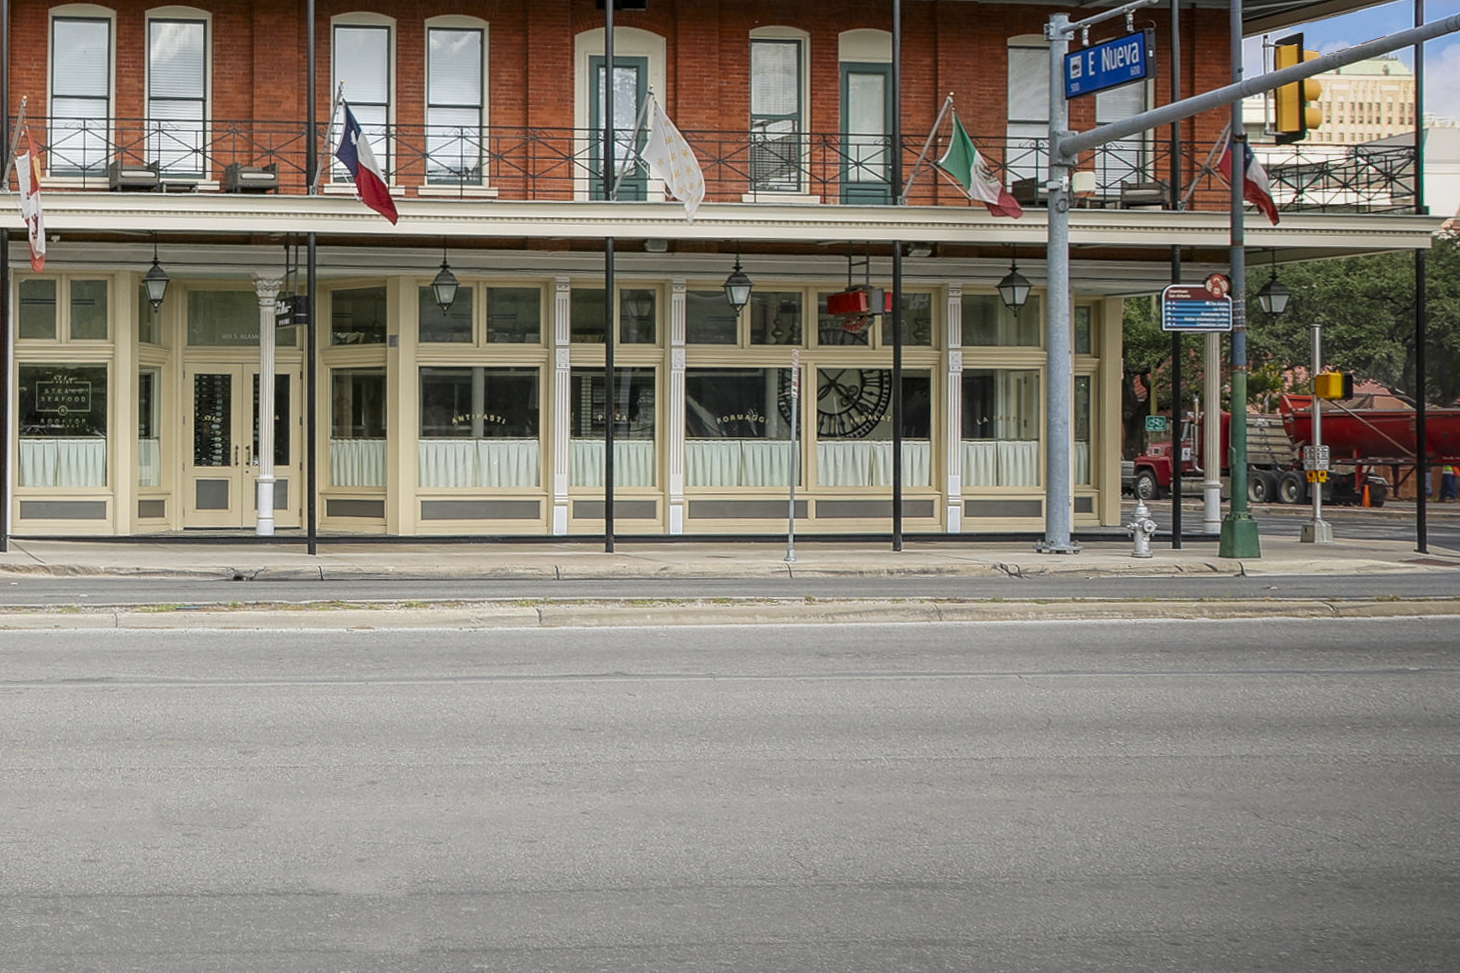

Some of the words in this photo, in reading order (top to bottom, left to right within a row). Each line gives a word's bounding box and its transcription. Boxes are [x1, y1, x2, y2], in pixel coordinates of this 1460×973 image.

[1088, 50, 1096, 76] E
[1101, 41, 1140, 73] Nueva
[451, 413, 507, 426] ANTIPASTI
[597, 414, 627, 422] PZA
[716, 413, 769, 424] FORMAGGI
[850, 414, 893, 425] INSALAT
